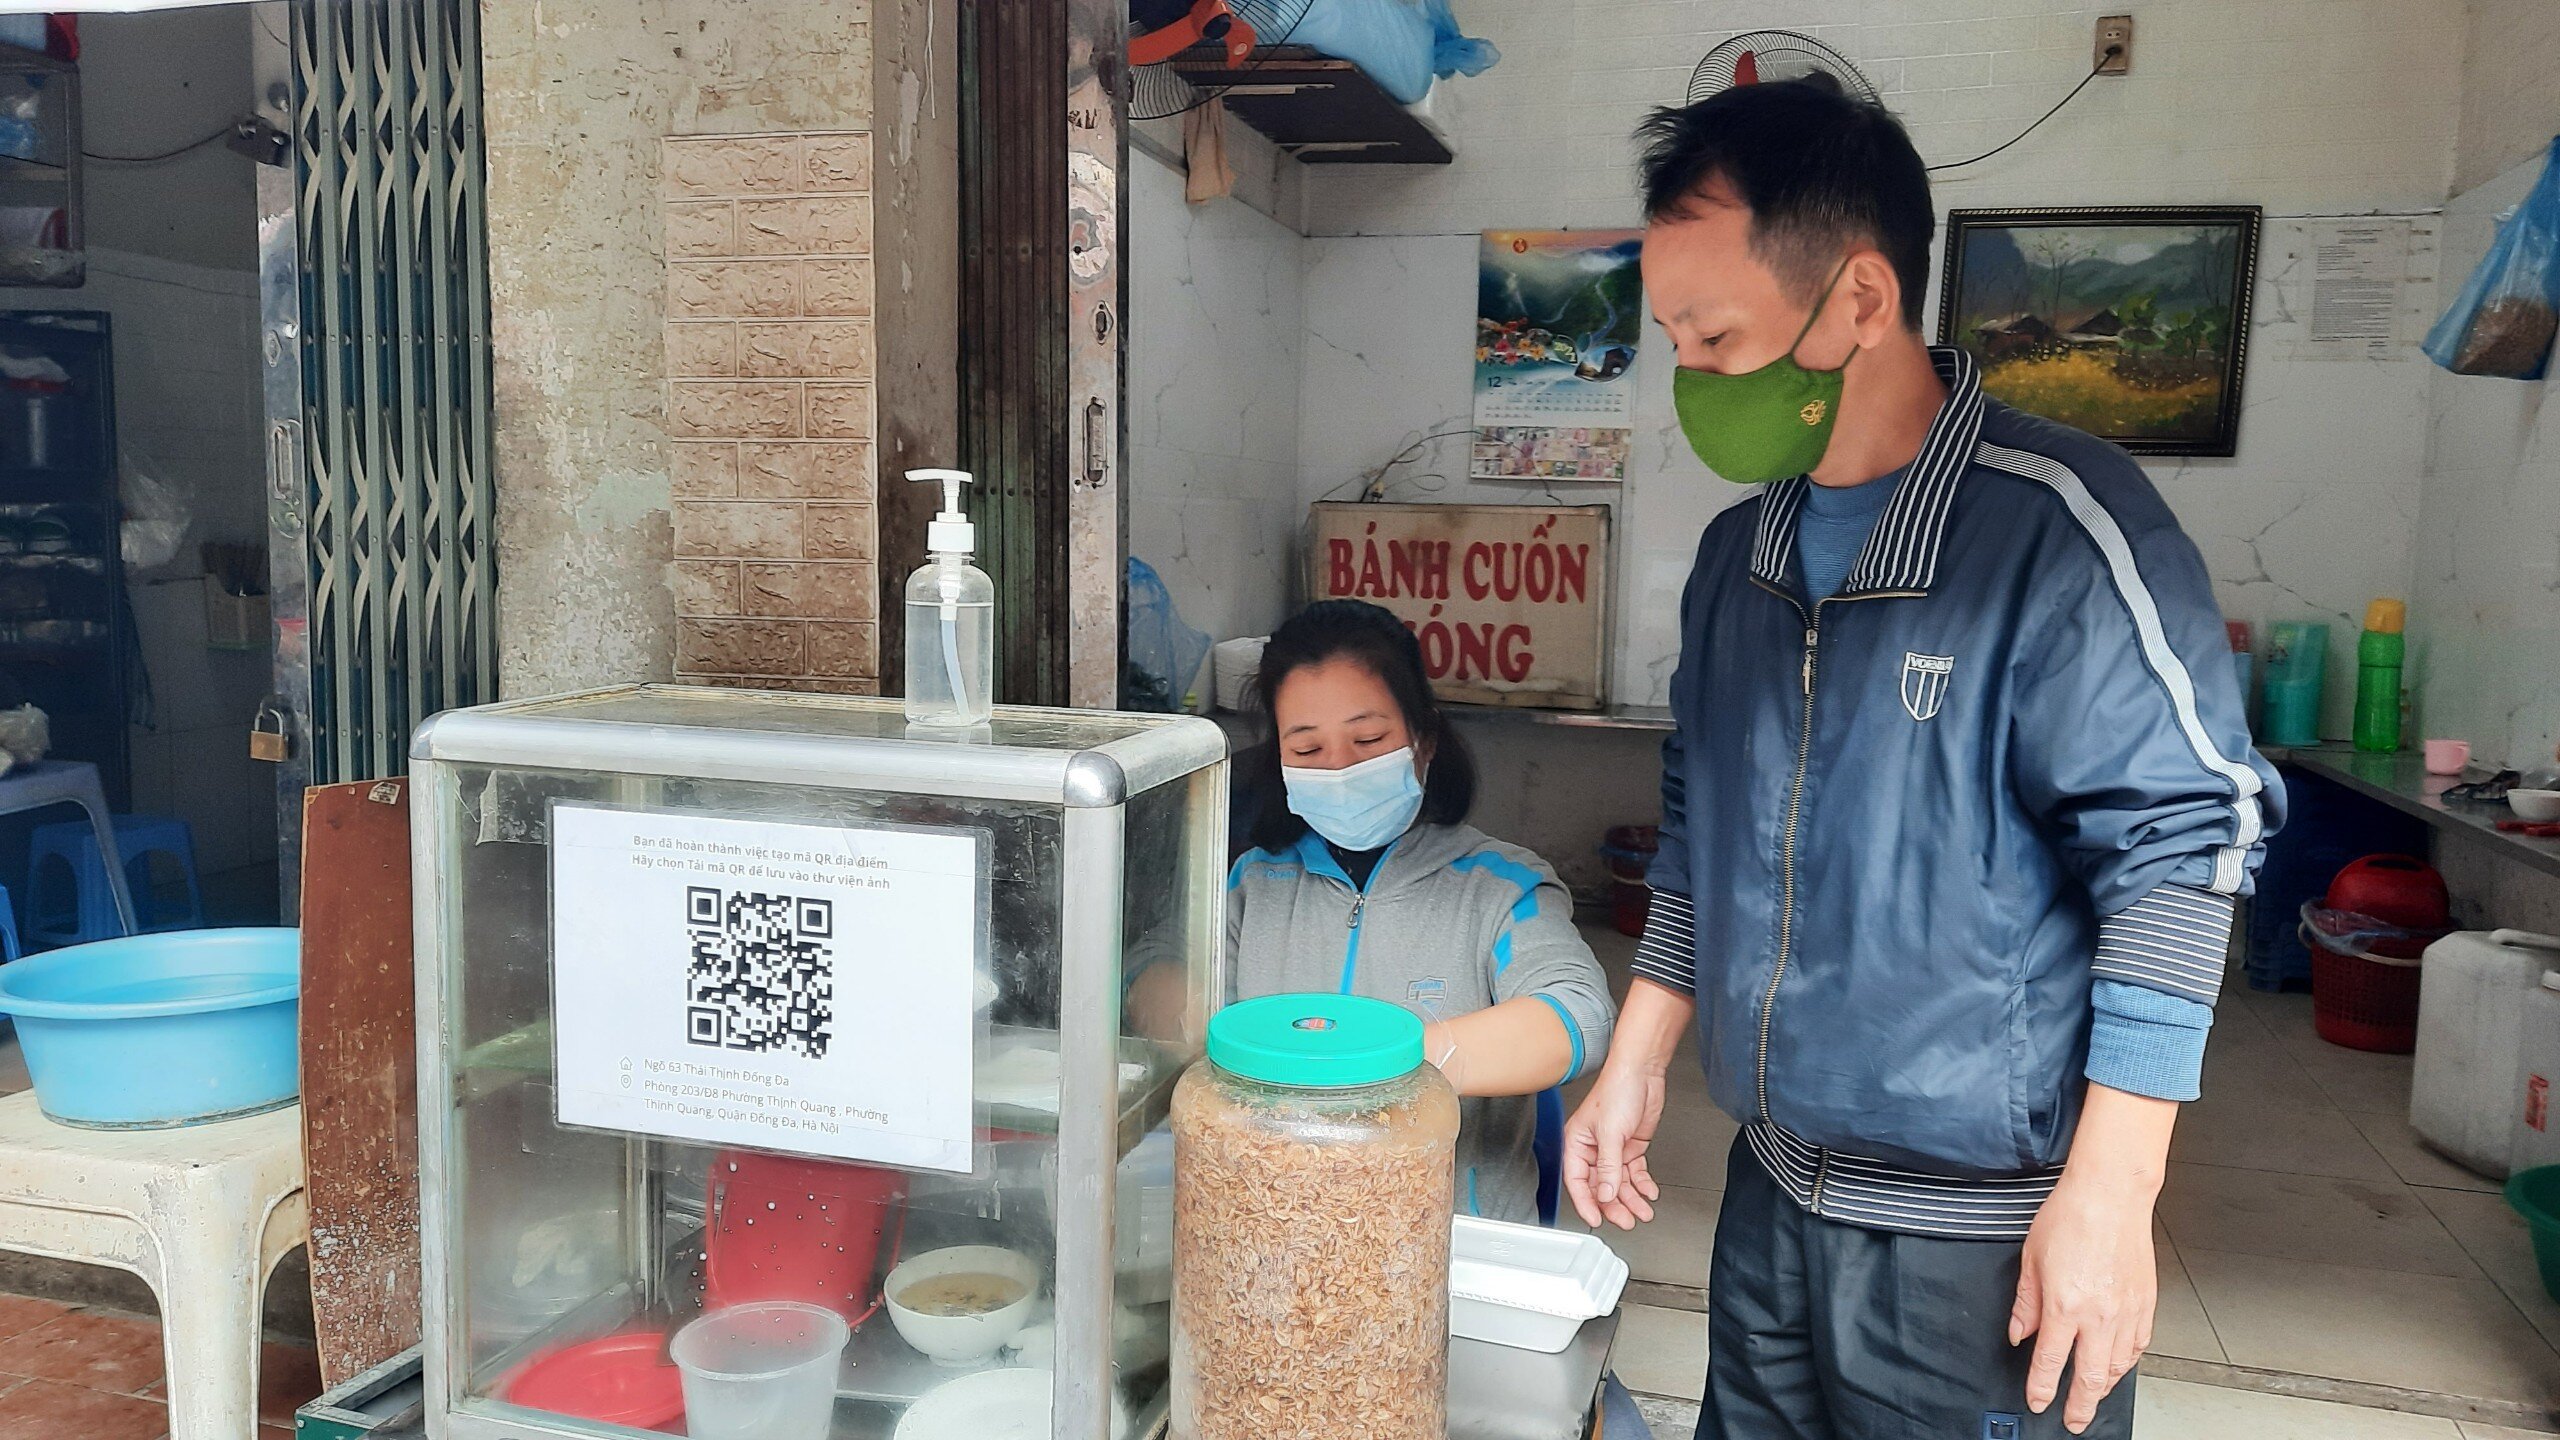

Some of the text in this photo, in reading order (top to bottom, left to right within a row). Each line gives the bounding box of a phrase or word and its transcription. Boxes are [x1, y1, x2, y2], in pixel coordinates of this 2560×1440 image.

[1488, 376, 1501, 388] 12
[1328, 514, 1590, 603] BÁNH CUỐN
[1404, 603, 1535, 683] ÓNG
[633, 835, 655, 849] Bạn
[658, 837, 673, 849] đã
[675, 838, 704, 851] hoàn
[708, 842, 742, 855] thành
[745, 846, 769, 859] việc
[771, 849, 790, 862] tạo
[793, 852, 811, 863] mã
[814, 853, 832, 865] QR
[835, 855, 854, 868] địa
[632, 854, 654, 868] Hãy
[656, 857, 684, 871] chọn
[687, 858, 704, 871] Tải
[707, 862, 725, 873] mã
[728, 864, 745, 876] QR
[766, 866, 785, 879] lưu
[789, 870, 809, 881] vào
[812, 872, 835, 884] thư
[837, 875, 864, 888] viện
[867, 876, 890, 889] ảnh
[644, 1058, 666, 1073] Ngõ
[668, 1062, 681, 1073] 63
[684, 1063, 707, 1076] Thái
[774, 1075, 789, 1086] Đa
[644, 1080, 678, 1097] Phòng
[681, 1084, 719, 1099] 203/Đ8
[722, 1089, 764, 1107] Phường
[800, 1099, 836, 1117] Quang
[845, 1106, 888, 1124] Phường
[717, 1108, 747, 1123] Quận
[802, 1119, 817, 1131] Hà
[820, 1121, 839, 1135] Nội
